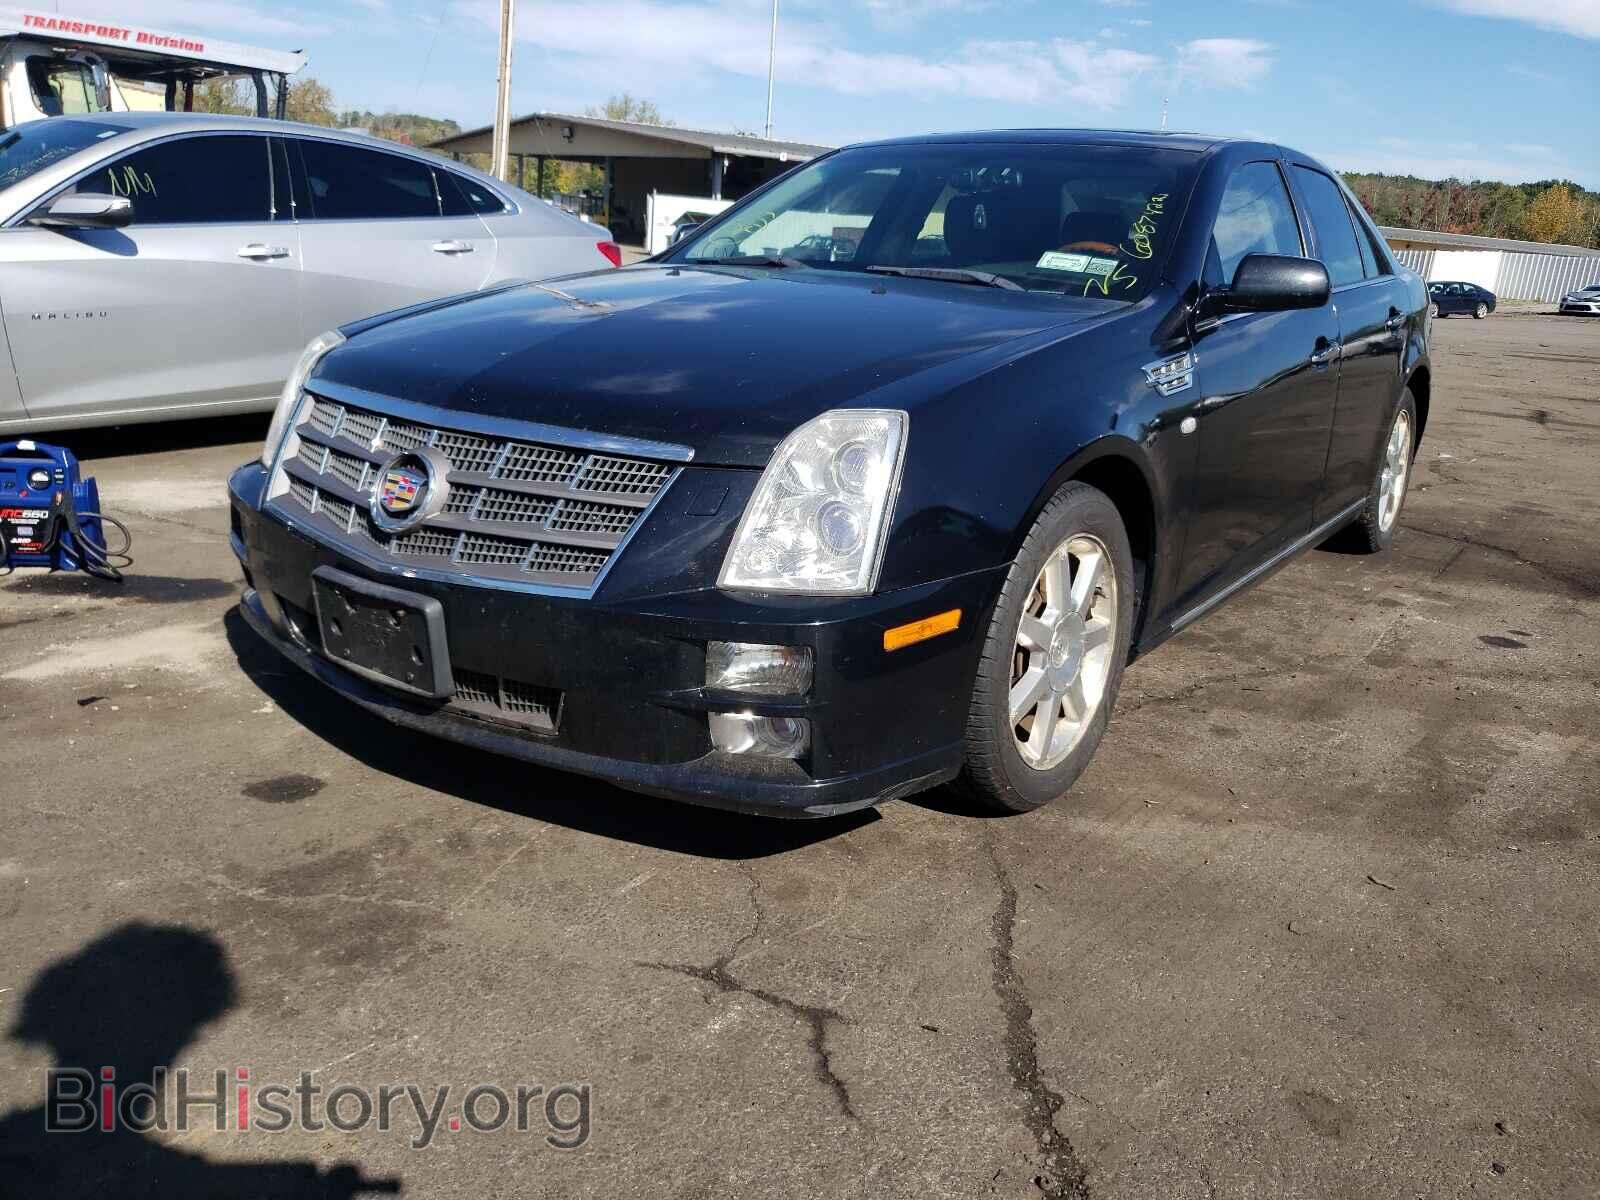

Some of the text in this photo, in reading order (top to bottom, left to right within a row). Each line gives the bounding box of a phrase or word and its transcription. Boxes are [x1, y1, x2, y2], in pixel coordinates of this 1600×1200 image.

[23, 15, 204, 53] TRANSPORT Division
[31, 311, 108, 321] MALIBU
